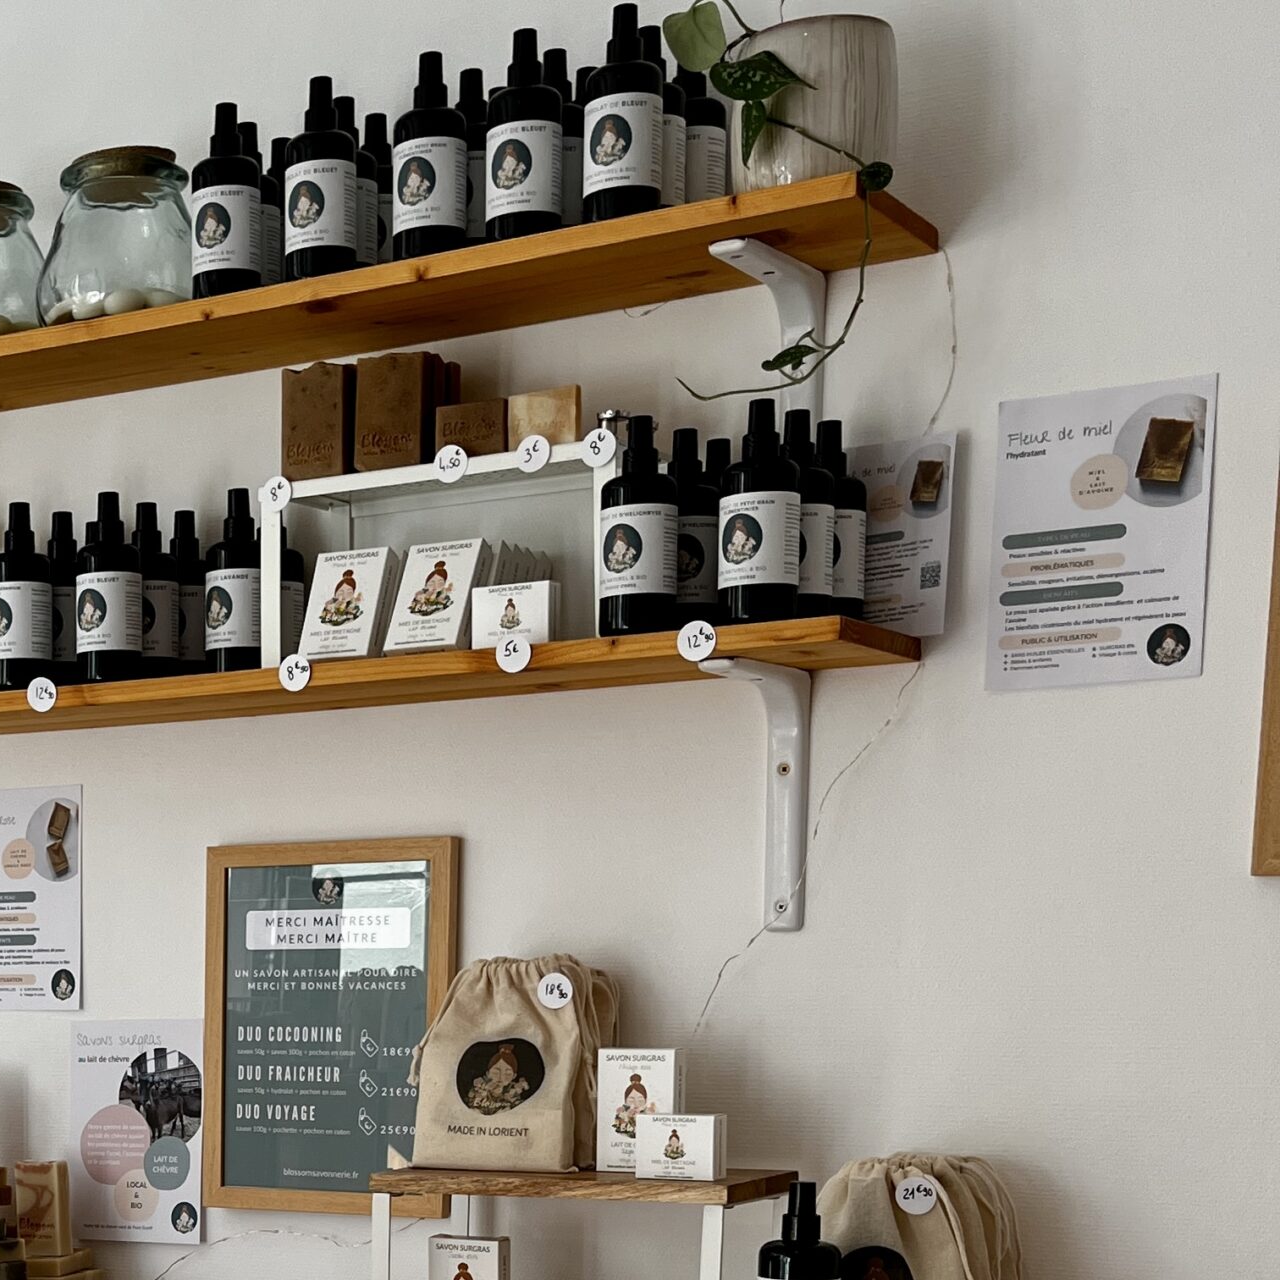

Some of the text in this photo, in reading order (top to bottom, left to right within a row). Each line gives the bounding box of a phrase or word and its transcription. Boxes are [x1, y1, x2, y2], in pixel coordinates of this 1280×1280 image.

[521, 125, 547, 133] BLEUET
[1008, 420, 1112, 447] Fleur de miel
[590, 432, 605, 455] 8€
[524, 440, 539, 463] 3€
[270, 481, 284, 501] 8€
[1079, 487, 1114, 496] D'AVOINE
[416, 542, 473, 554] SAVON SURGRAS
[324, 551, 379, 563] SAVON SURGRAS
[1030, 559, 1094, 572] PROBLÉMATIQUES
[420, 617, 451, 625] BRETAGNE
[688, 627, 714, 648] 12€90
[1021, 637, 1046, 645] PUBLIC
[1054, 633, 1098, 642] UTILISATION
[504, 640, 519, 657] 5€
[265, 914, 390, 928] MERCI MAÎTRESSE
[276, 931, 377, 944] MERCI MAÎTRE
[234, 969, 417, 978] UN SAVON ARTISANL POUR DIRE
[248, 982, 280, 990] MERCI
[300, 982, 343, 990] BONNES
[348, 982, 407, 990] VACANCES
[77, 1033, 113, 1046] Savons
[237, 1026, 342, 1043] DUO COCOONING
[382, 1047, 412, 1057] 18€9
[108, 1055, 130, 1063] chèvre
[237, 1065, 341, 1083] DUO FRAICHEUR
[381, 1087, 417, 1097] 21€90
[236, 1103, 316, 1121] DUO VOYAGE
[380, 1125, 416, 1135] 25€90
[447, 1125, 475, 1136] MADE
[488, 1127, 529, 1137] LORIENT
[152, 1164, 178, 1173] CHÈVRE
[283, 1168, 360, 1179] blossomsavonnerie.fr
[903, 1184, 933, 1200] 21€90
[460, 1244, 491, 1253] SURGRAS
